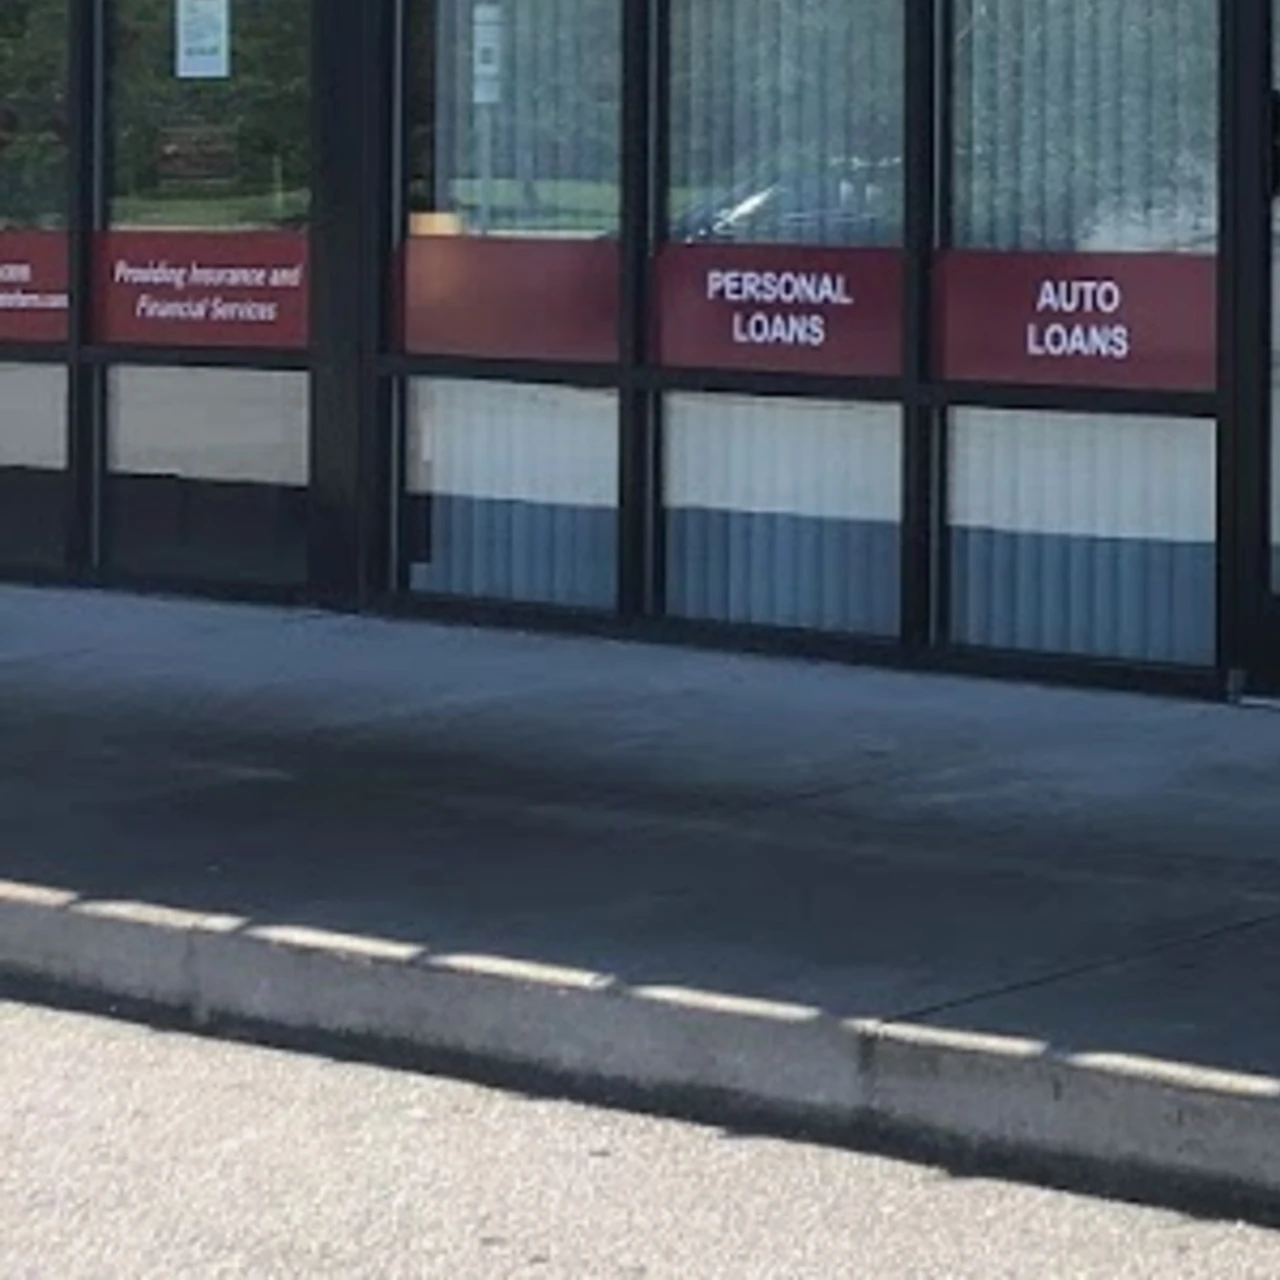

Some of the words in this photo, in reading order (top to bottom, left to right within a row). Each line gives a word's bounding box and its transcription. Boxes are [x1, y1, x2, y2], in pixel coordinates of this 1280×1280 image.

[114, 260, 186, 290] Providing
[188, 261, 266, 287] Insurance
[269, 264, 303, 288] and
[707, 270, 853, 304] PERSONAL
[136, 293, 211, 318] Financial
[209, 296, 279, 321] Services
[1037, 280, 1120, 313] AUTO
[733, 313, 825, 346] LOANS
[1027, 324, 1129, 358] LOANS
